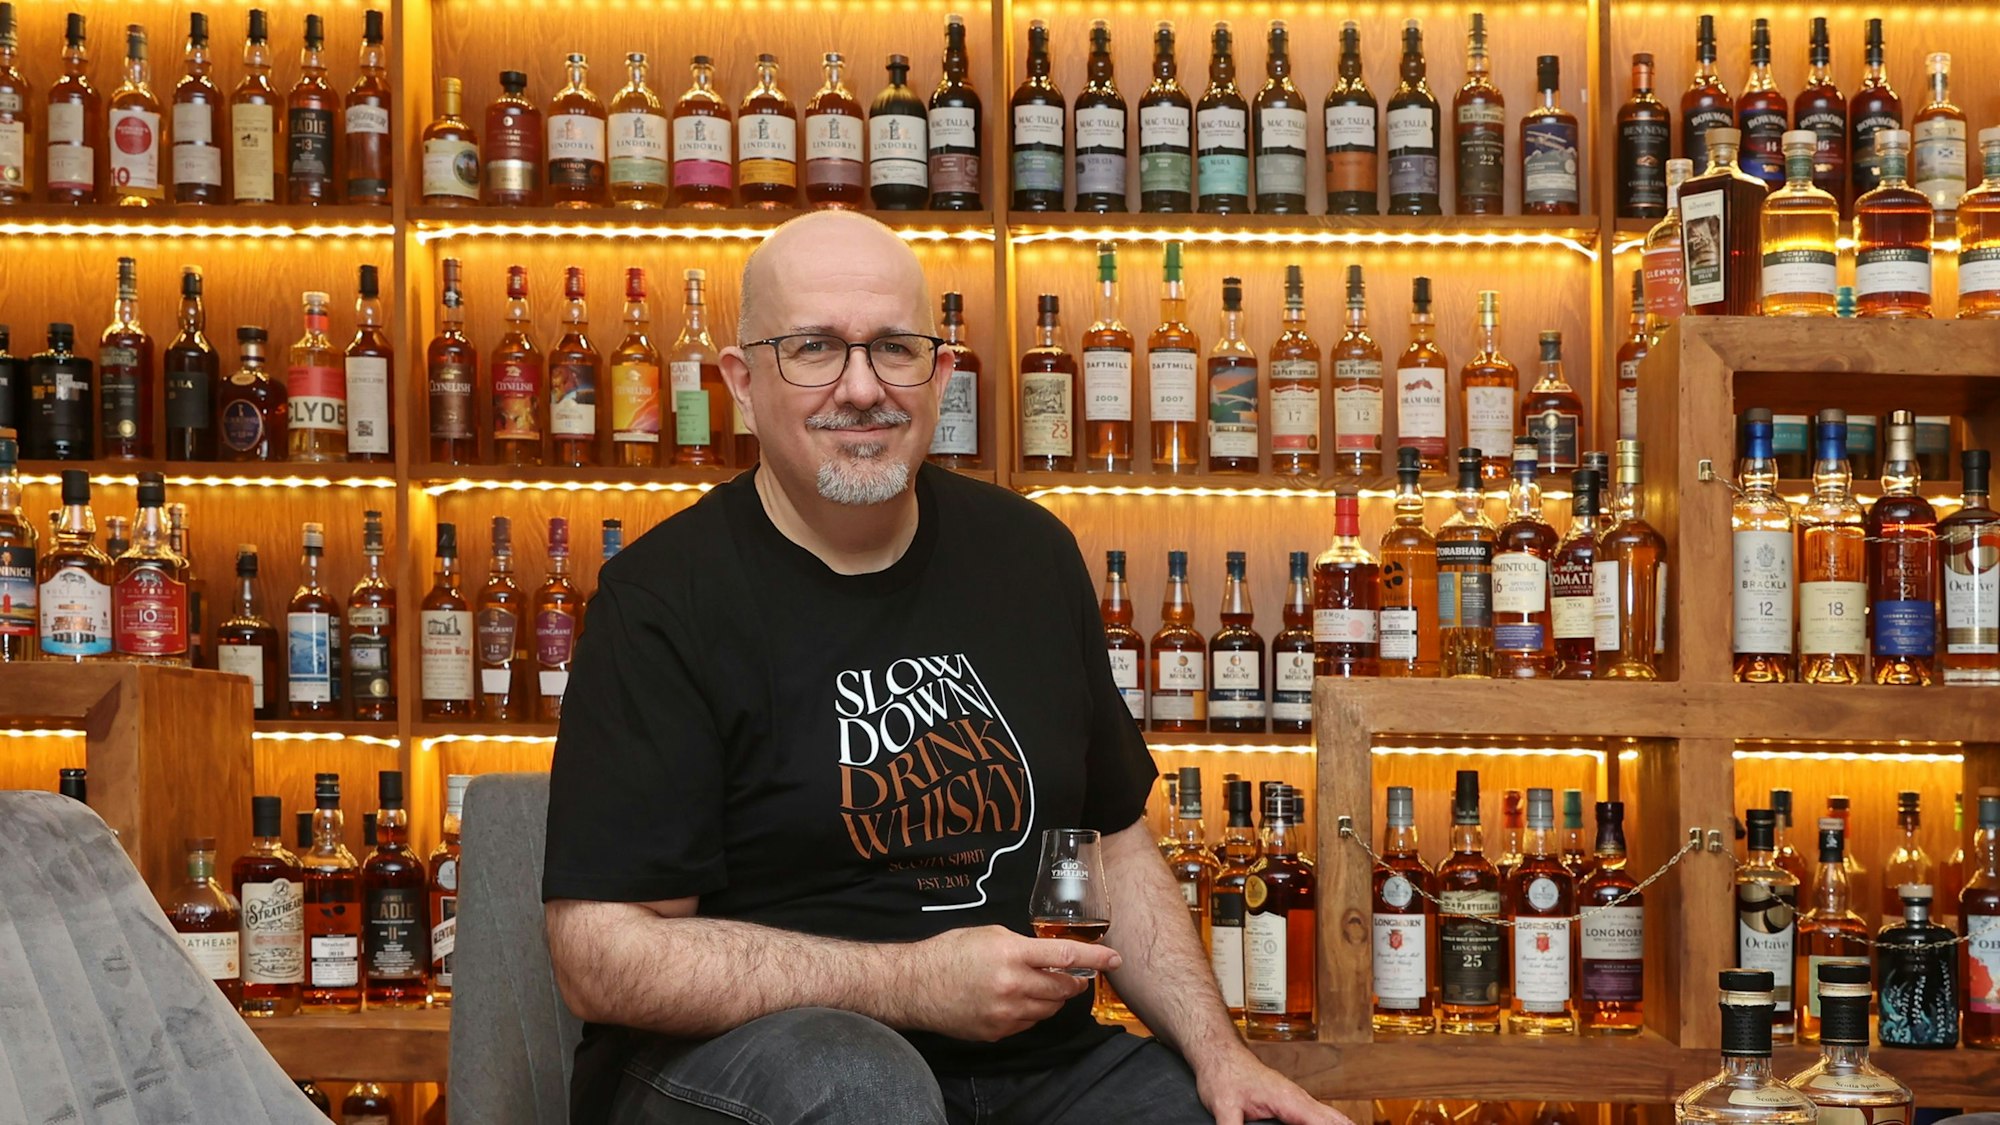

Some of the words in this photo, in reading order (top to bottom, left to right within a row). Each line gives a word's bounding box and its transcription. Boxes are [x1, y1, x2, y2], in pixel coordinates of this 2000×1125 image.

[291, 119, 327, 135] EADIE
[1480, 153, 1495, 165] 22
[111, 167, 130, 187] 10
[1086, 361, 1129, 370] DAFTMILL
[1152, 362, 1194, 371] DAFTMILL
[430, 380, 471, 393] CLYNELISH
[496, 381, 534, 392] CLYNELISH
[288, 401, 346, 425] CLYDE
[1288, 411, 1302, 422] 17
[1356, 411, 1370, 421] 12
[941, 426, 956, 442] 17
[1051, 423, 1069, 440] 23
[1461, 576, 1478, 584] 2017
[1742, 580, 1787, 590] BRACKLA
[1902, 584, 1917, 598] 21
[138, 608, 157, 623] 10
[1759, 602, 1774, 616] 12
[1827, 602, 1844, 616] 18
[490, 644, 500, 653] 12
[835, 653, 963, 718] SLOW
[837, 677, 994, 766] DOWN
[839, 719, 1020, 810] DRINK
[839, 764, 1025, 860] WHISKY
[948, 848, 986, 867] SPIRIT
[916, 876, 945, 890] EST.
[945, 874, 970, 889] 2013
[1374, 919, 1421, 928] LONGMORN
[1452, 944, 1492, 952] LONGMORN
[1744, 936, 1788, 950] Octave
[1462, 954, 1483, 968] 25
[1834, 1081, 1859, 1089] Scotia
[1755, 1095, 1779, 1103] Scotia
